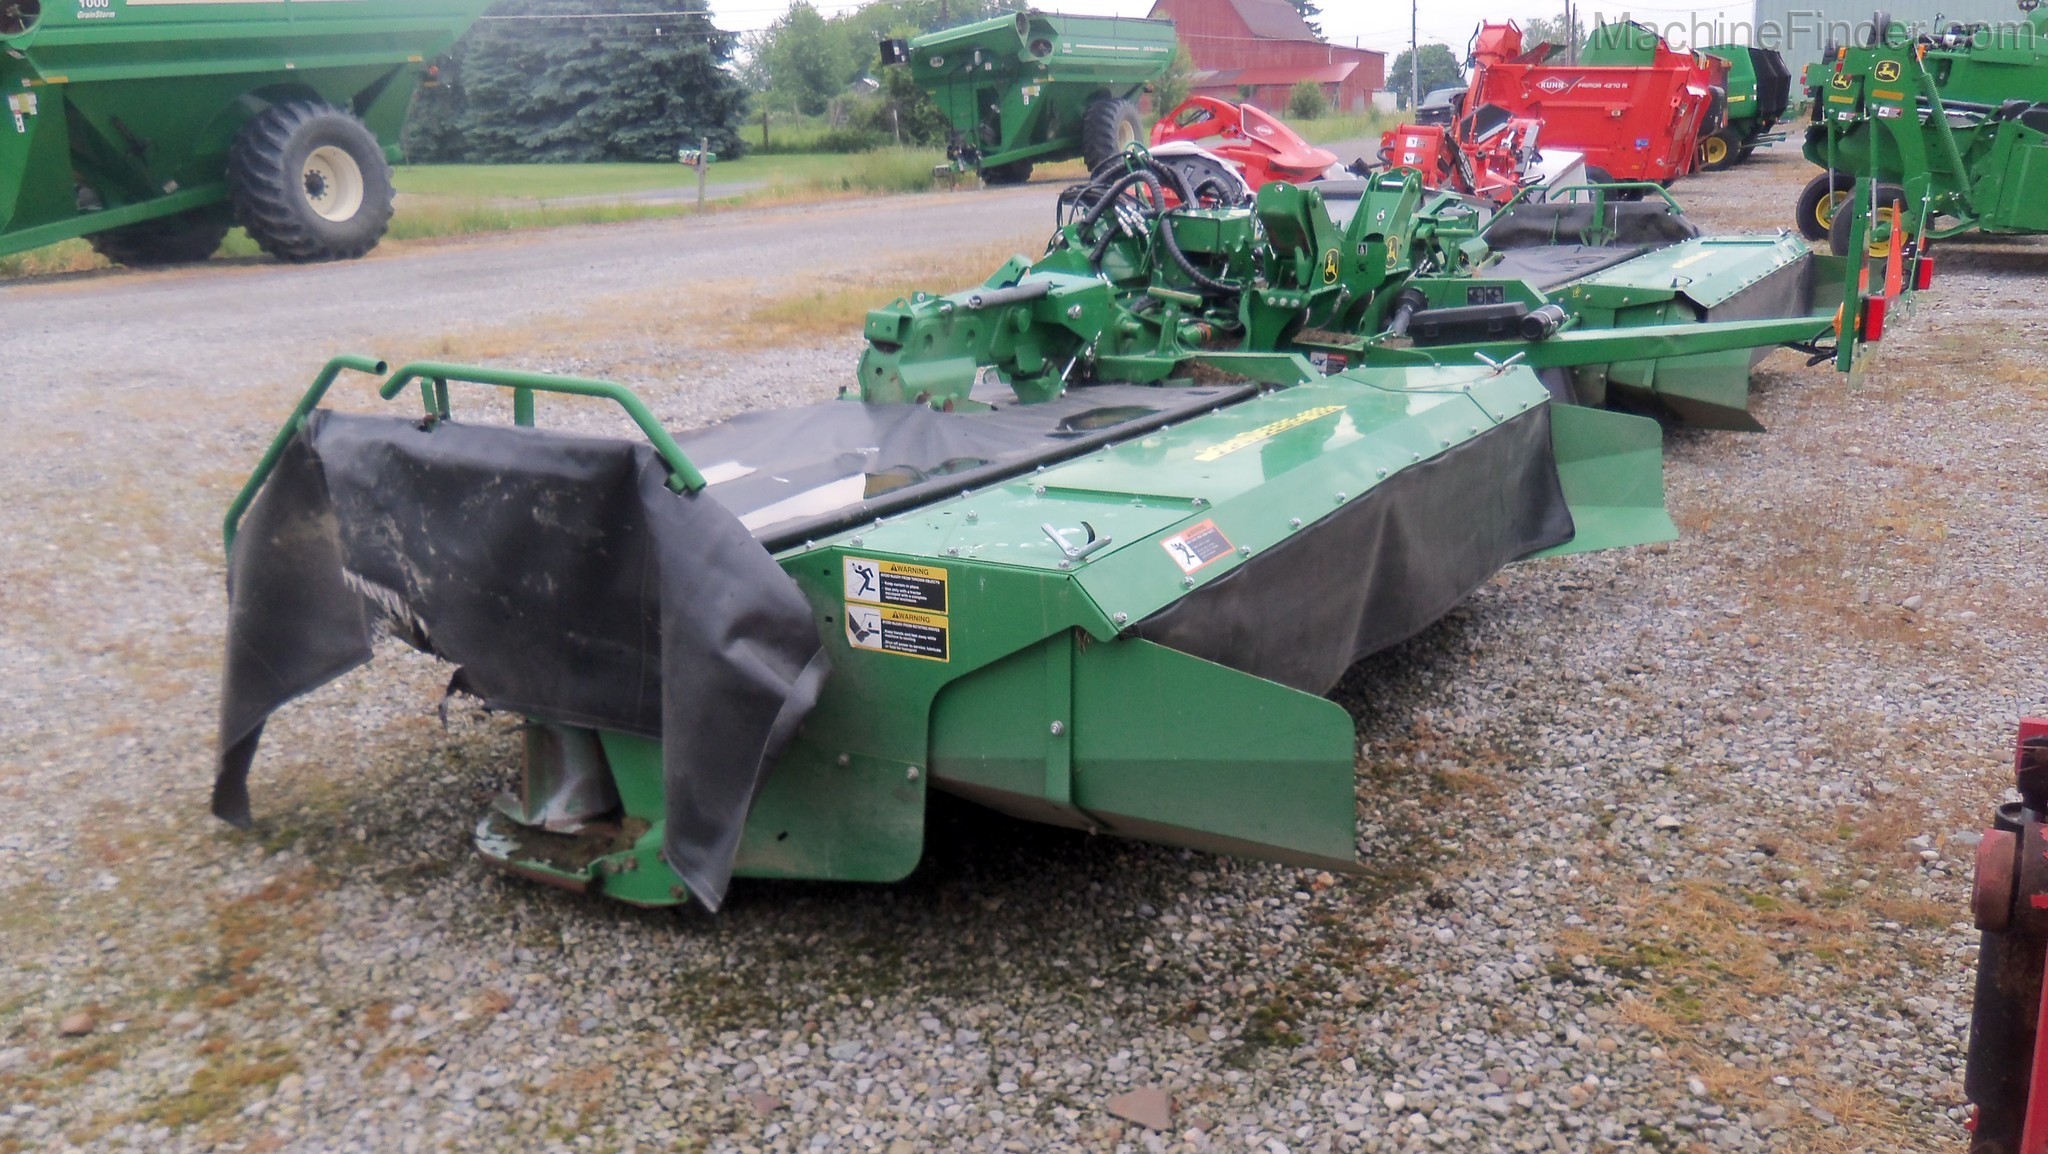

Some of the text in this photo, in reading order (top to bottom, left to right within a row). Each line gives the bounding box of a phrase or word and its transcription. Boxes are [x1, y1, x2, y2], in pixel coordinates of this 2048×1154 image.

[77, 10, 116, 19] GrainStorm
[897, 564, 928, 576] WARNING
[899, 612, 930, 623] WARNING
